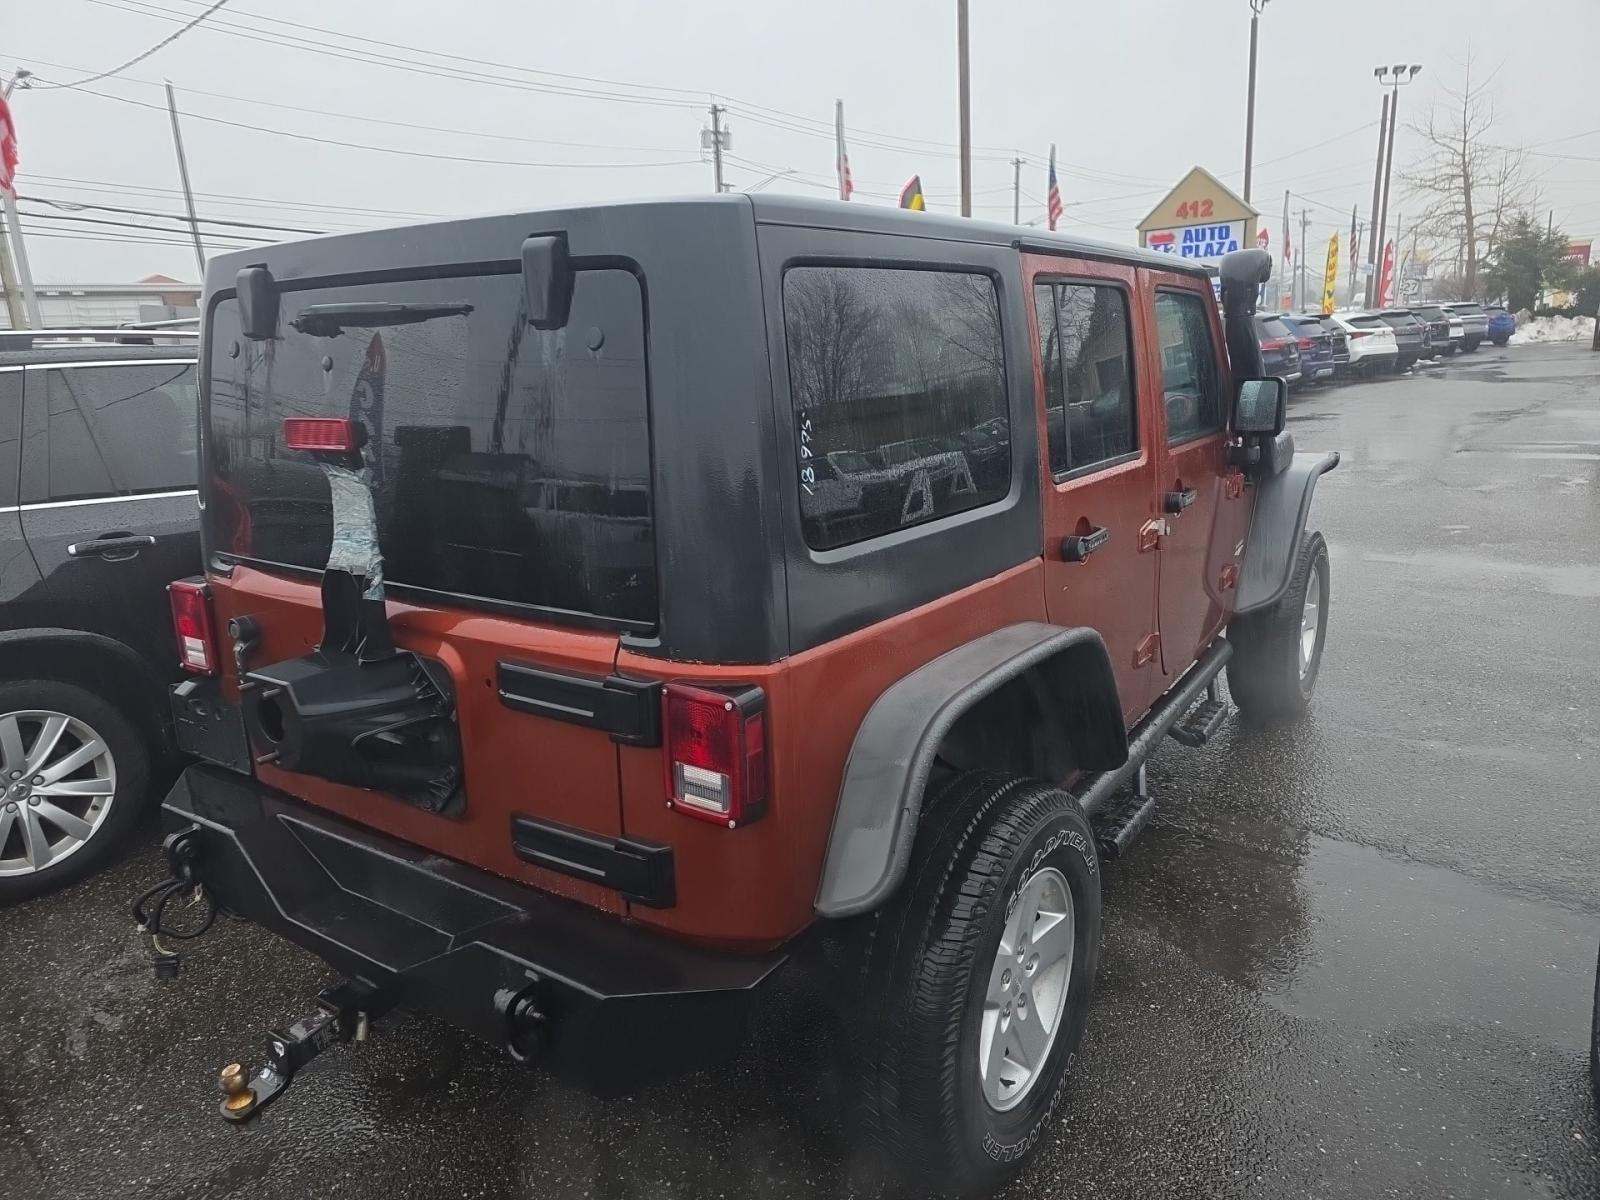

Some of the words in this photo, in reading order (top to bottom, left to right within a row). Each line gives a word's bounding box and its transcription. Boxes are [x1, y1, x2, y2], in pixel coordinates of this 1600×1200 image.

[1175, 198, 1214, 220] 412
[1182, 225, 1231, 244] AUTO
[1181, 239, 1239, 258] PLAZA
[1402, 282, 1417, 293] 27
[1004, 830, 1096, 925] GOODYEAR
[982, 1052, 1076, 1162] WRANGLER
